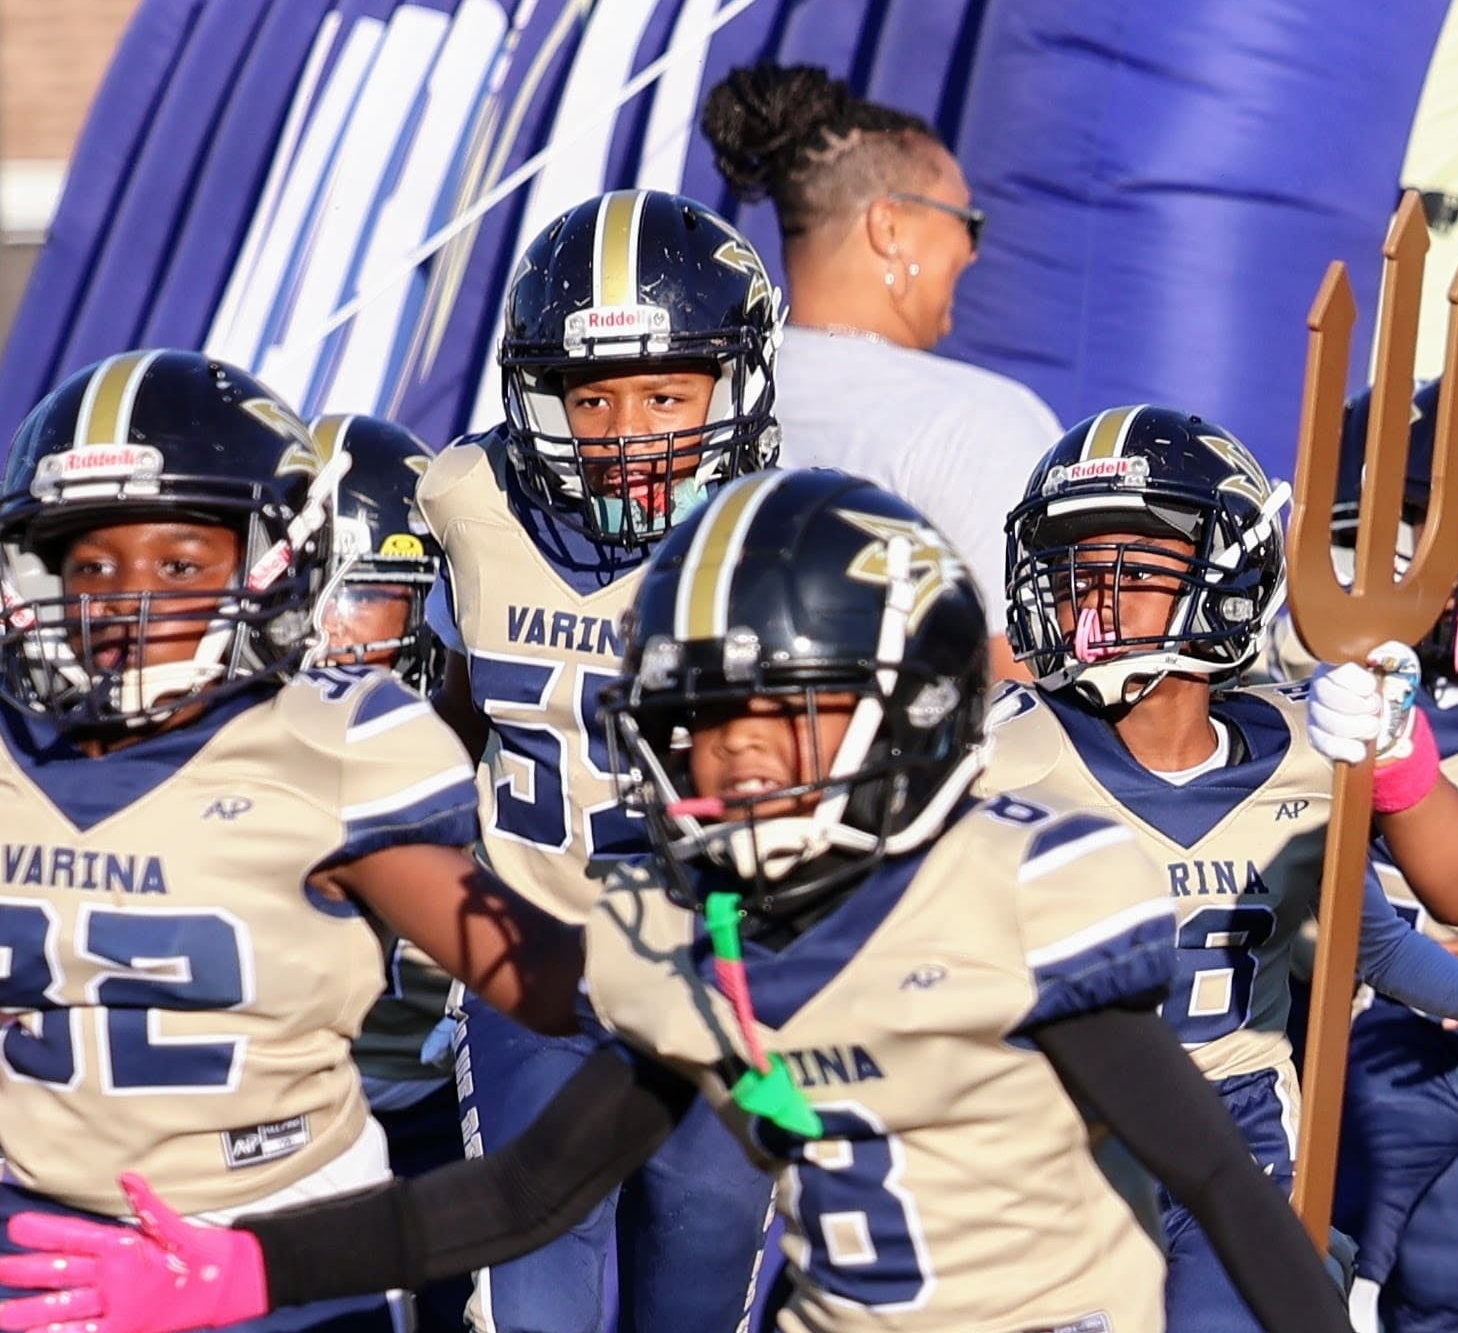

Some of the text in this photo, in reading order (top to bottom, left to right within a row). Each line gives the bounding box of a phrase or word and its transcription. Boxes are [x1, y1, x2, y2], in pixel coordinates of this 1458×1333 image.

[508, 605, 627, 658] VARIN
[3, 844, 168, 895] VARINA
[751, 1099, 938, 1315] 8
